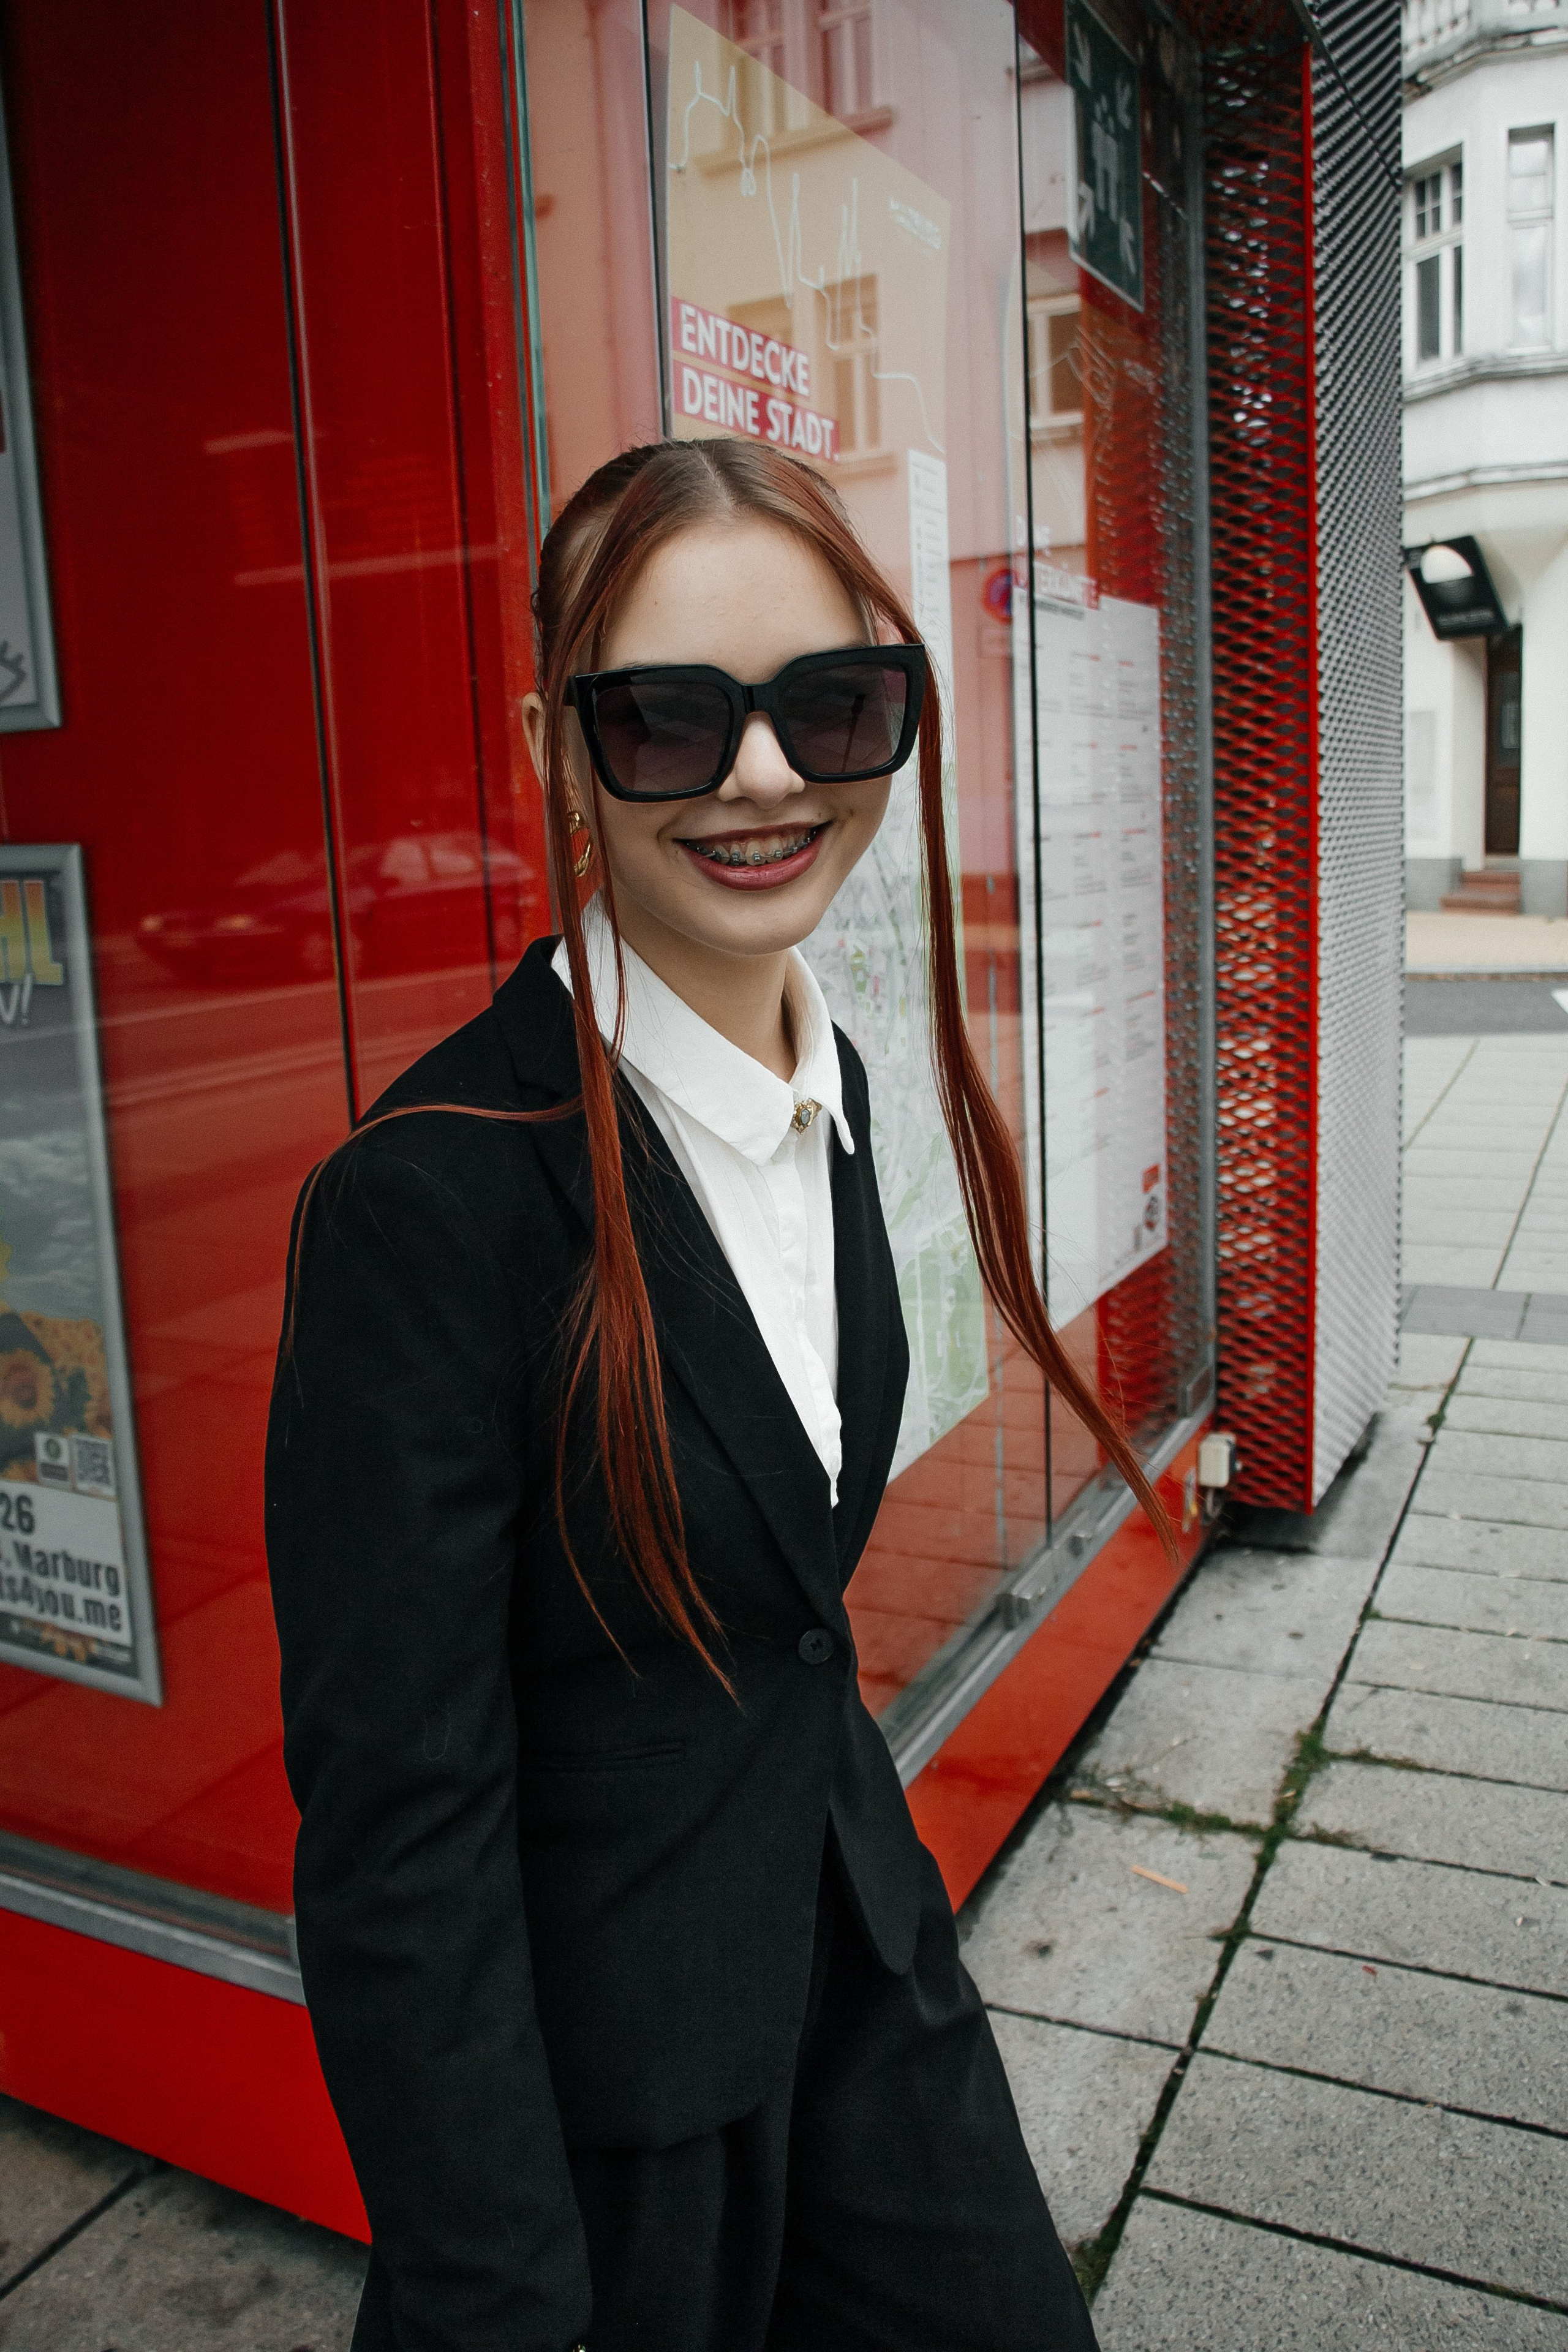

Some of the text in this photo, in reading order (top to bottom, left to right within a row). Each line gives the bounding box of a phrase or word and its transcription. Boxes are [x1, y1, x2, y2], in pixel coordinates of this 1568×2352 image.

[680, 304, 810, 396] ENTDECKE
[682, 367, 840, 462] DEINE STADT.
[13, 1540, 120, 1597] Marburg
